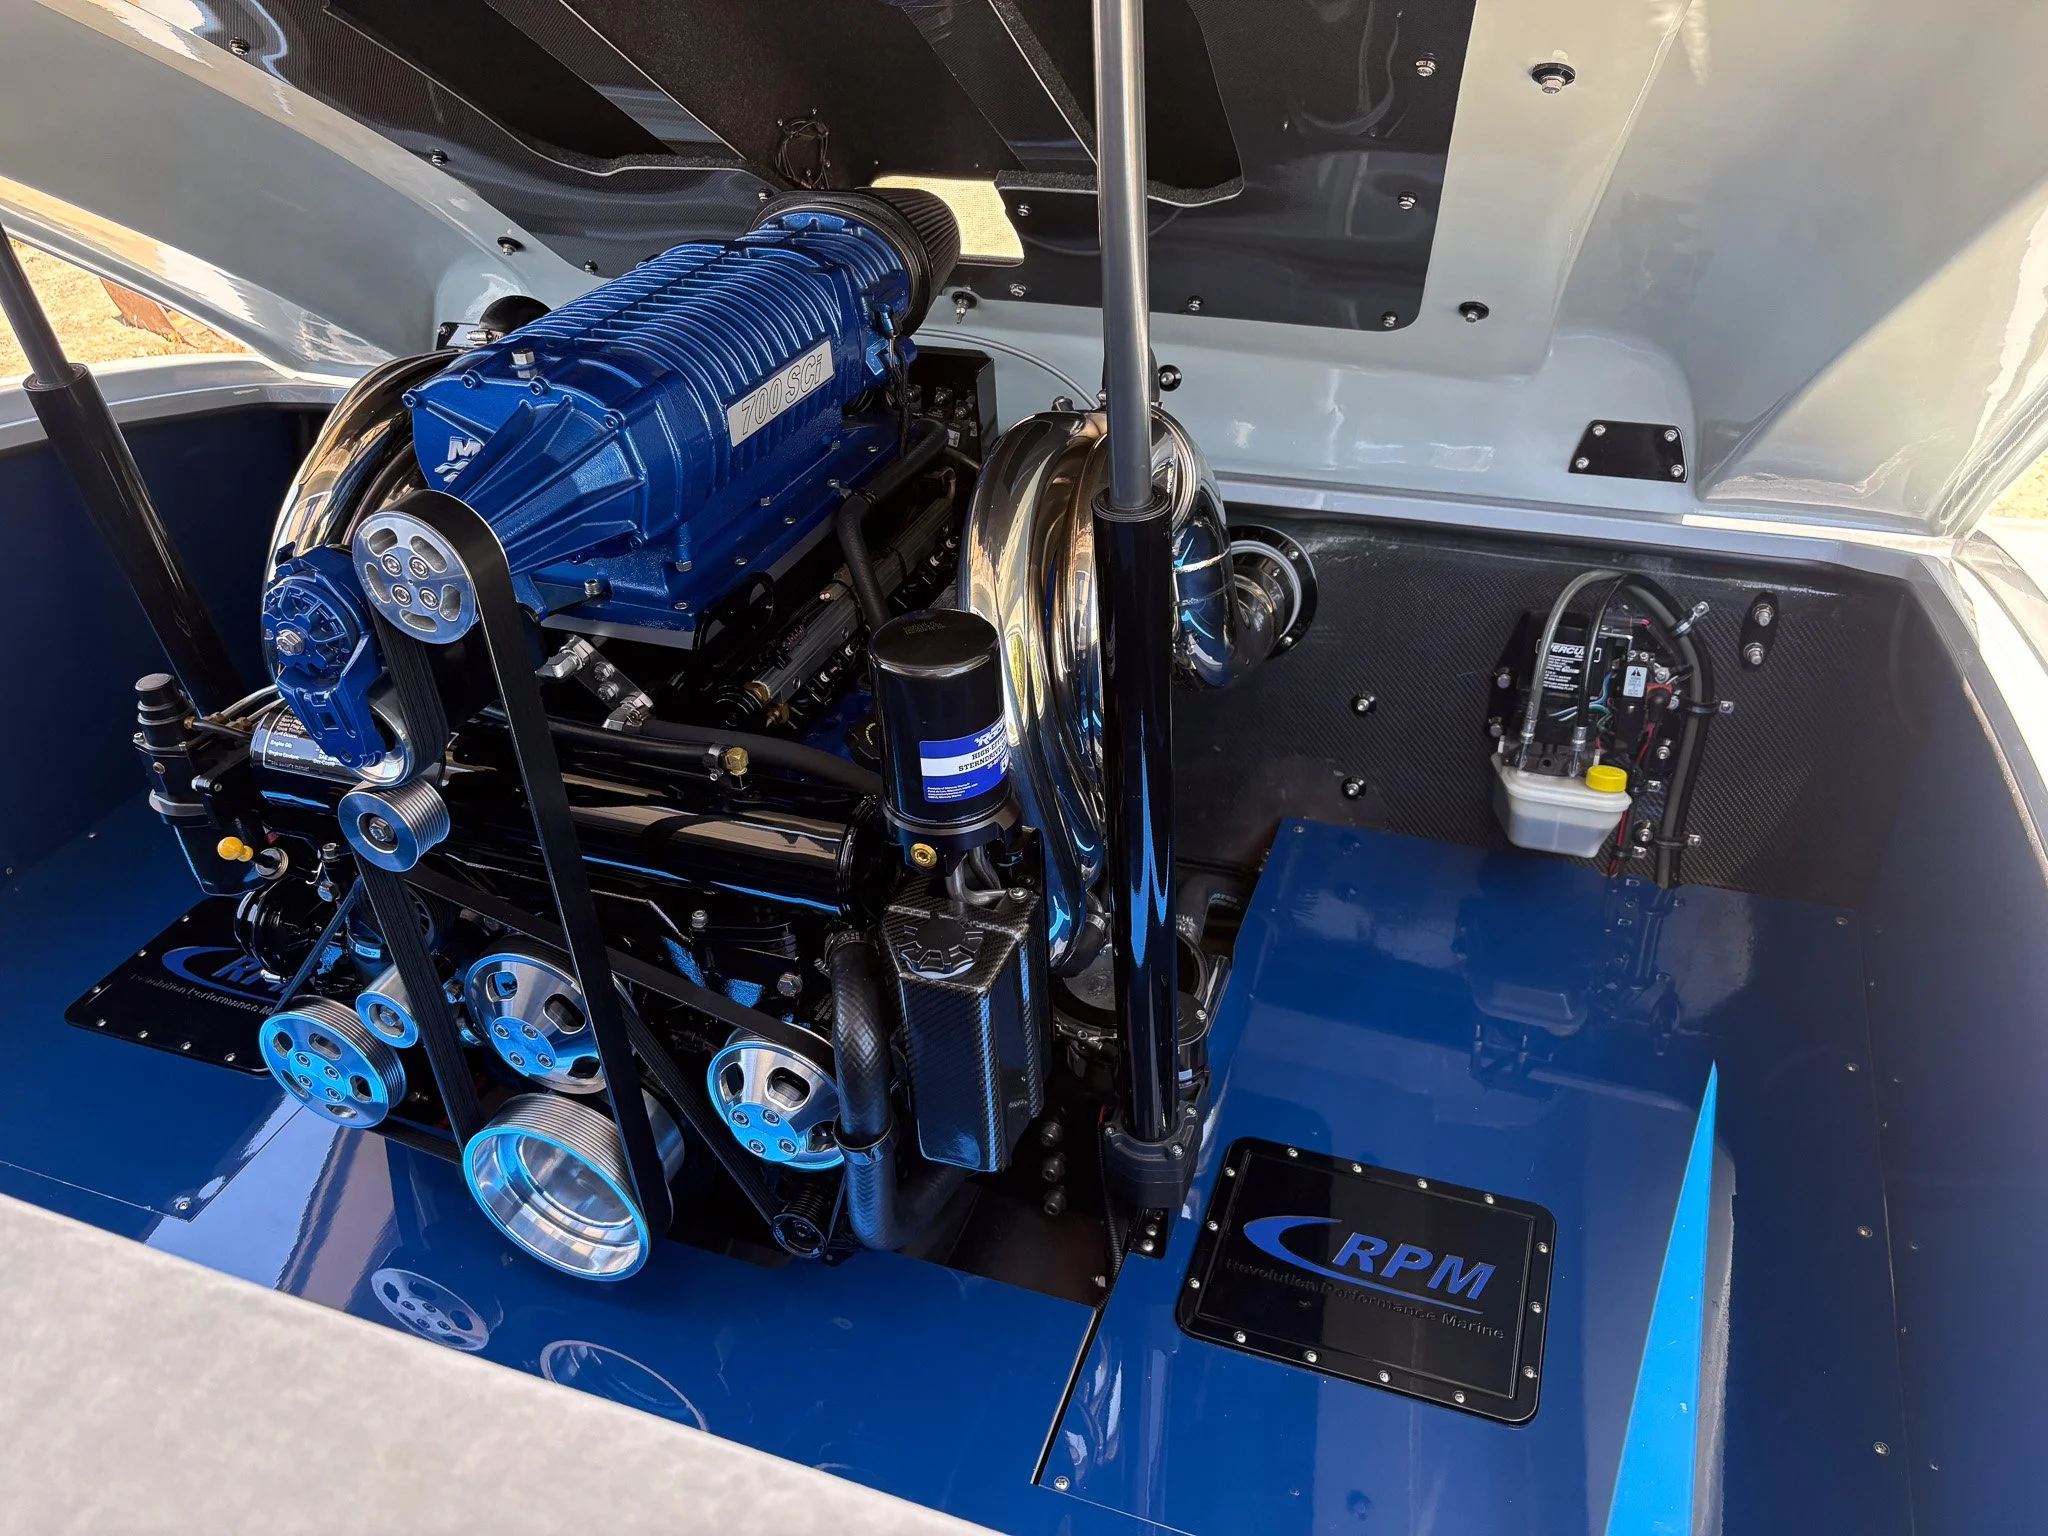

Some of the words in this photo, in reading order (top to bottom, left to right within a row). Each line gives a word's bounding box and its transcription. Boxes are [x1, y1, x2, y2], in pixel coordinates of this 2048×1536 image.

[741, 377, 783, 436] 700
[785, 353, 823, 404] SCi
[1332, 1232, 1498, 1300] RPM
[1319, 1281, 1437, 1322] Performance
[1441, 1312, 1505, 1340] Marine
